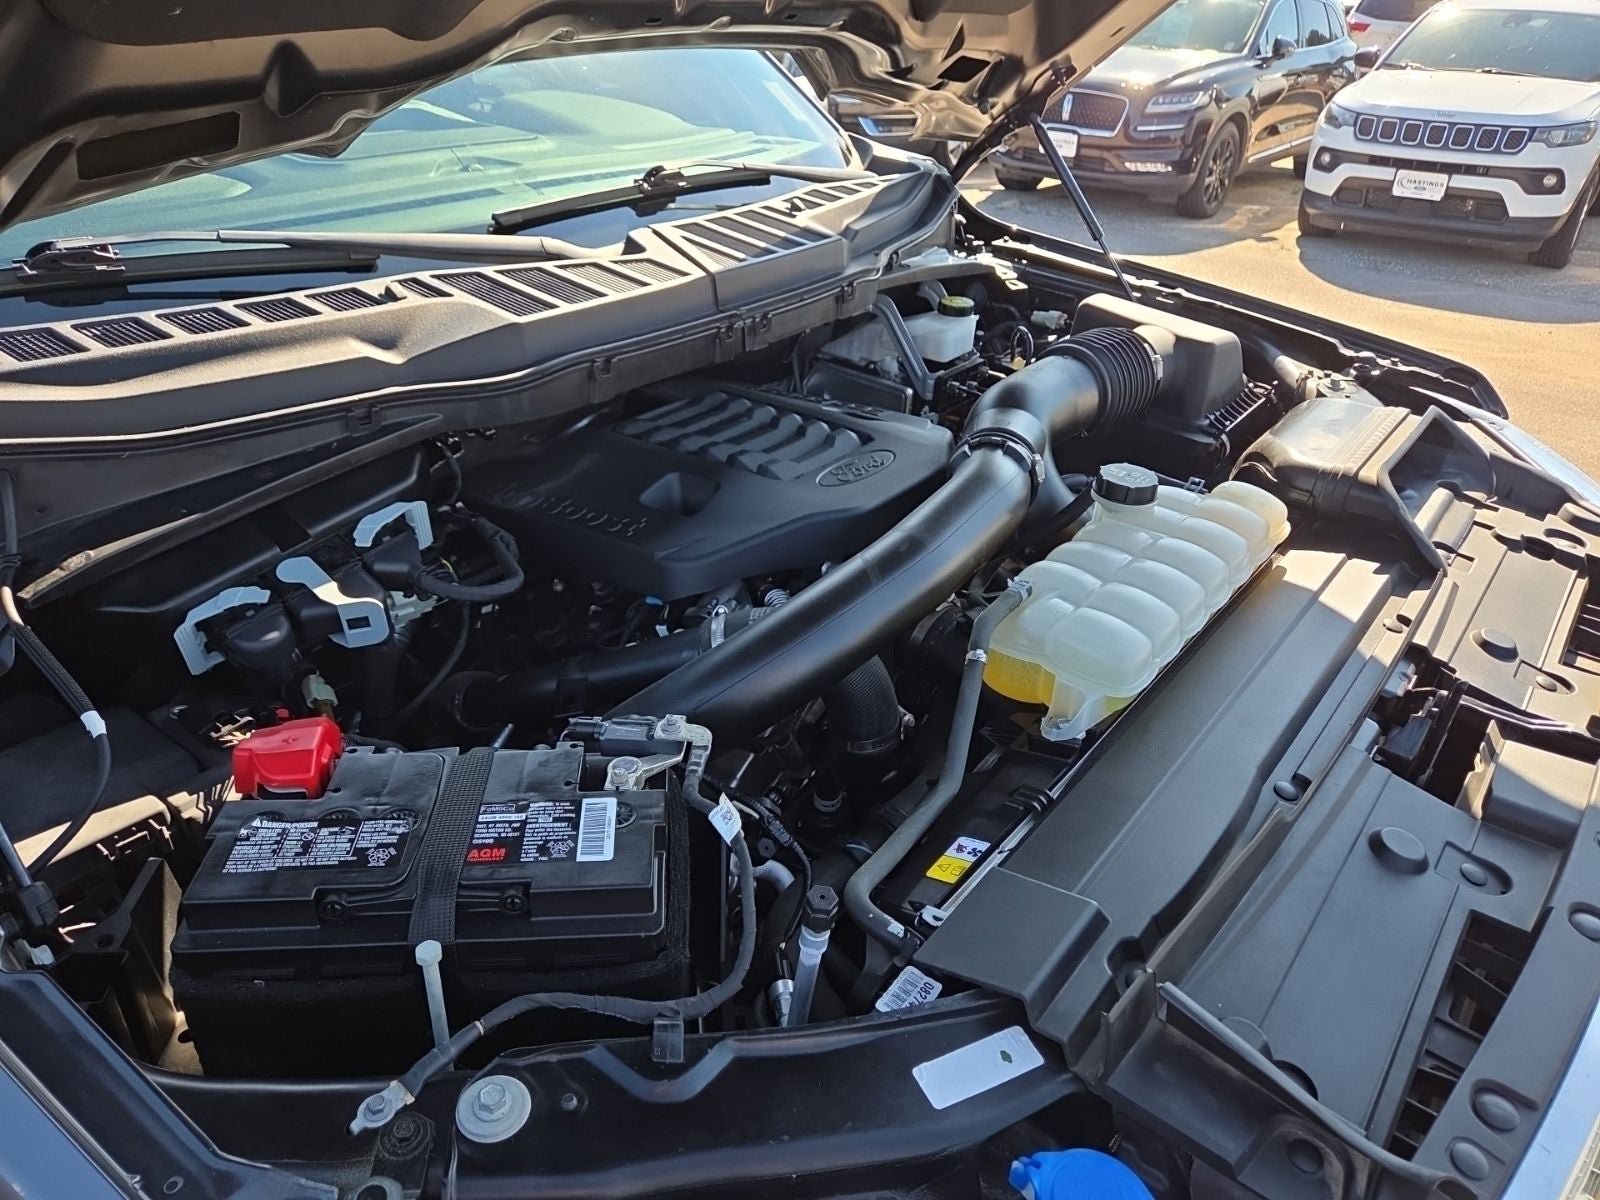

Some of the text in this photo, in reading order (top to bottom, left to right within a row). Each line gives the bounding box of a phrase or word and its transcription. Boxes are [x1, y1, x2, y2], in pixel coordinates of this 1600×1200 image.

[1406, 179, 1444, 188] HASTINGS
[831, 454, 887, 482] Ford
[468, 848, 506, 858] AGM
